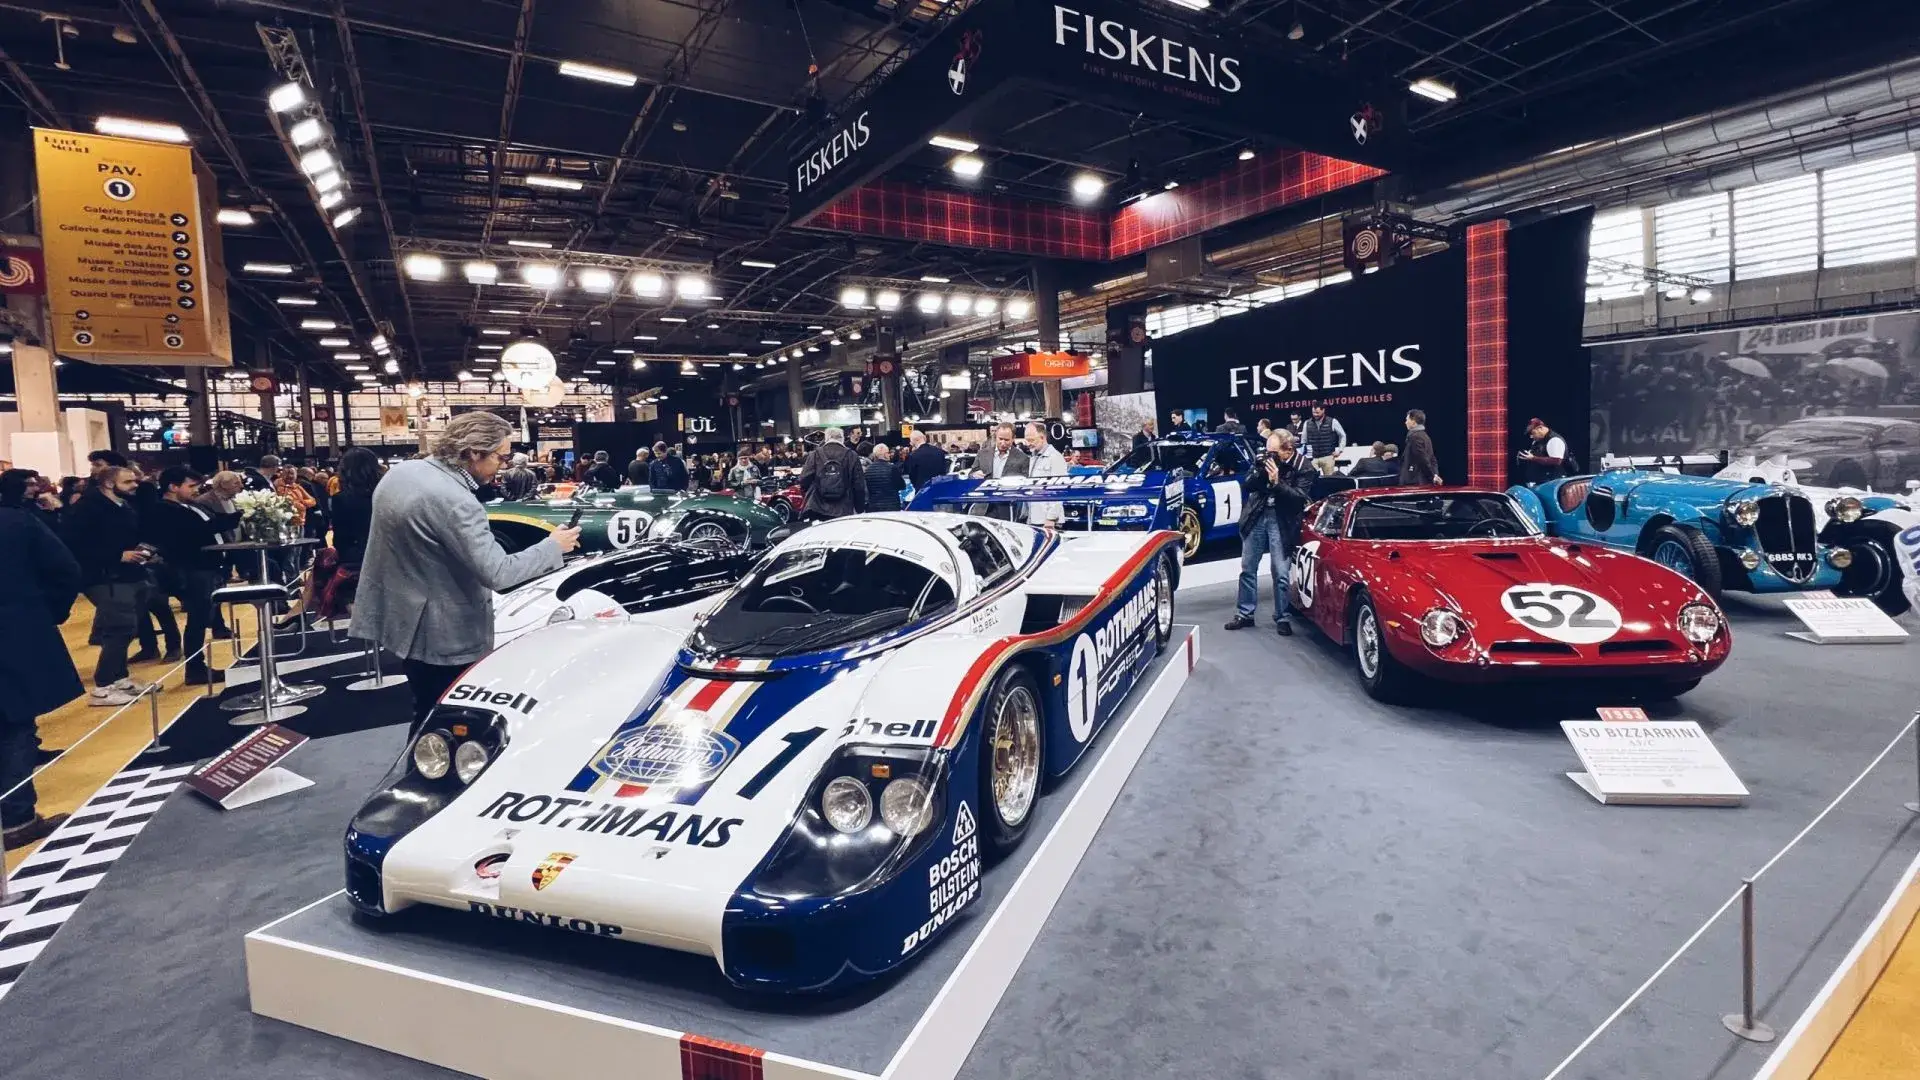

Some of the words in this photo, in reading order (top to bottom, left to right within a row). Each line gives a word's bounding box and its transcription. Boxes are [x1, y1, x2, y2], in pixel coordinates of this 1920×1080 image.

[1054, 5, 1242, 92] FISKENS
[97, 163, 142, 177] PAV.
[797, 111, 870, 193] FISKENS
[59, 224, 99, 233] Galerie
[102, 226, 122, 235] des
[83, 205, 123, 216] Galerie
[146, 243, 168, 252] Arts
[70, 289, 108, 299] Quand
[1743, 327, 1774, 350] 24
[1229, 344, 1422, 397] FISKENS
[1251, 403, 1270, 411] FINE
[1323, 393, 1393, 406] AUTOMOBILES
[1224, 493, 1231, 519] 1
[1298, 546, 1312, 598] 52
[1768, 554, 1794, 562] 6885
[1095, 578, 1157, 672] ROTHMANS
[1508, 590, 1617, 629] 52
[448, 684, 539, 714] Shell
[1076, 648, 1088, 726] 1
[838, 717, 938, 739] Shell
[1572, 728, 1600, 738] ISO
[1605, 728, 1701, 738] BIZZARRINI
[736, 726, 828, 800] 1
[477, 791, 744, 848] ROTHMANS
[929, 835, 978, 888] BOSCH
[930, 858, 980, 913] BILSTEIN
[467, 900, 623, 938] DUNLOP
[901, 881, 979, 955] DUNLOP
